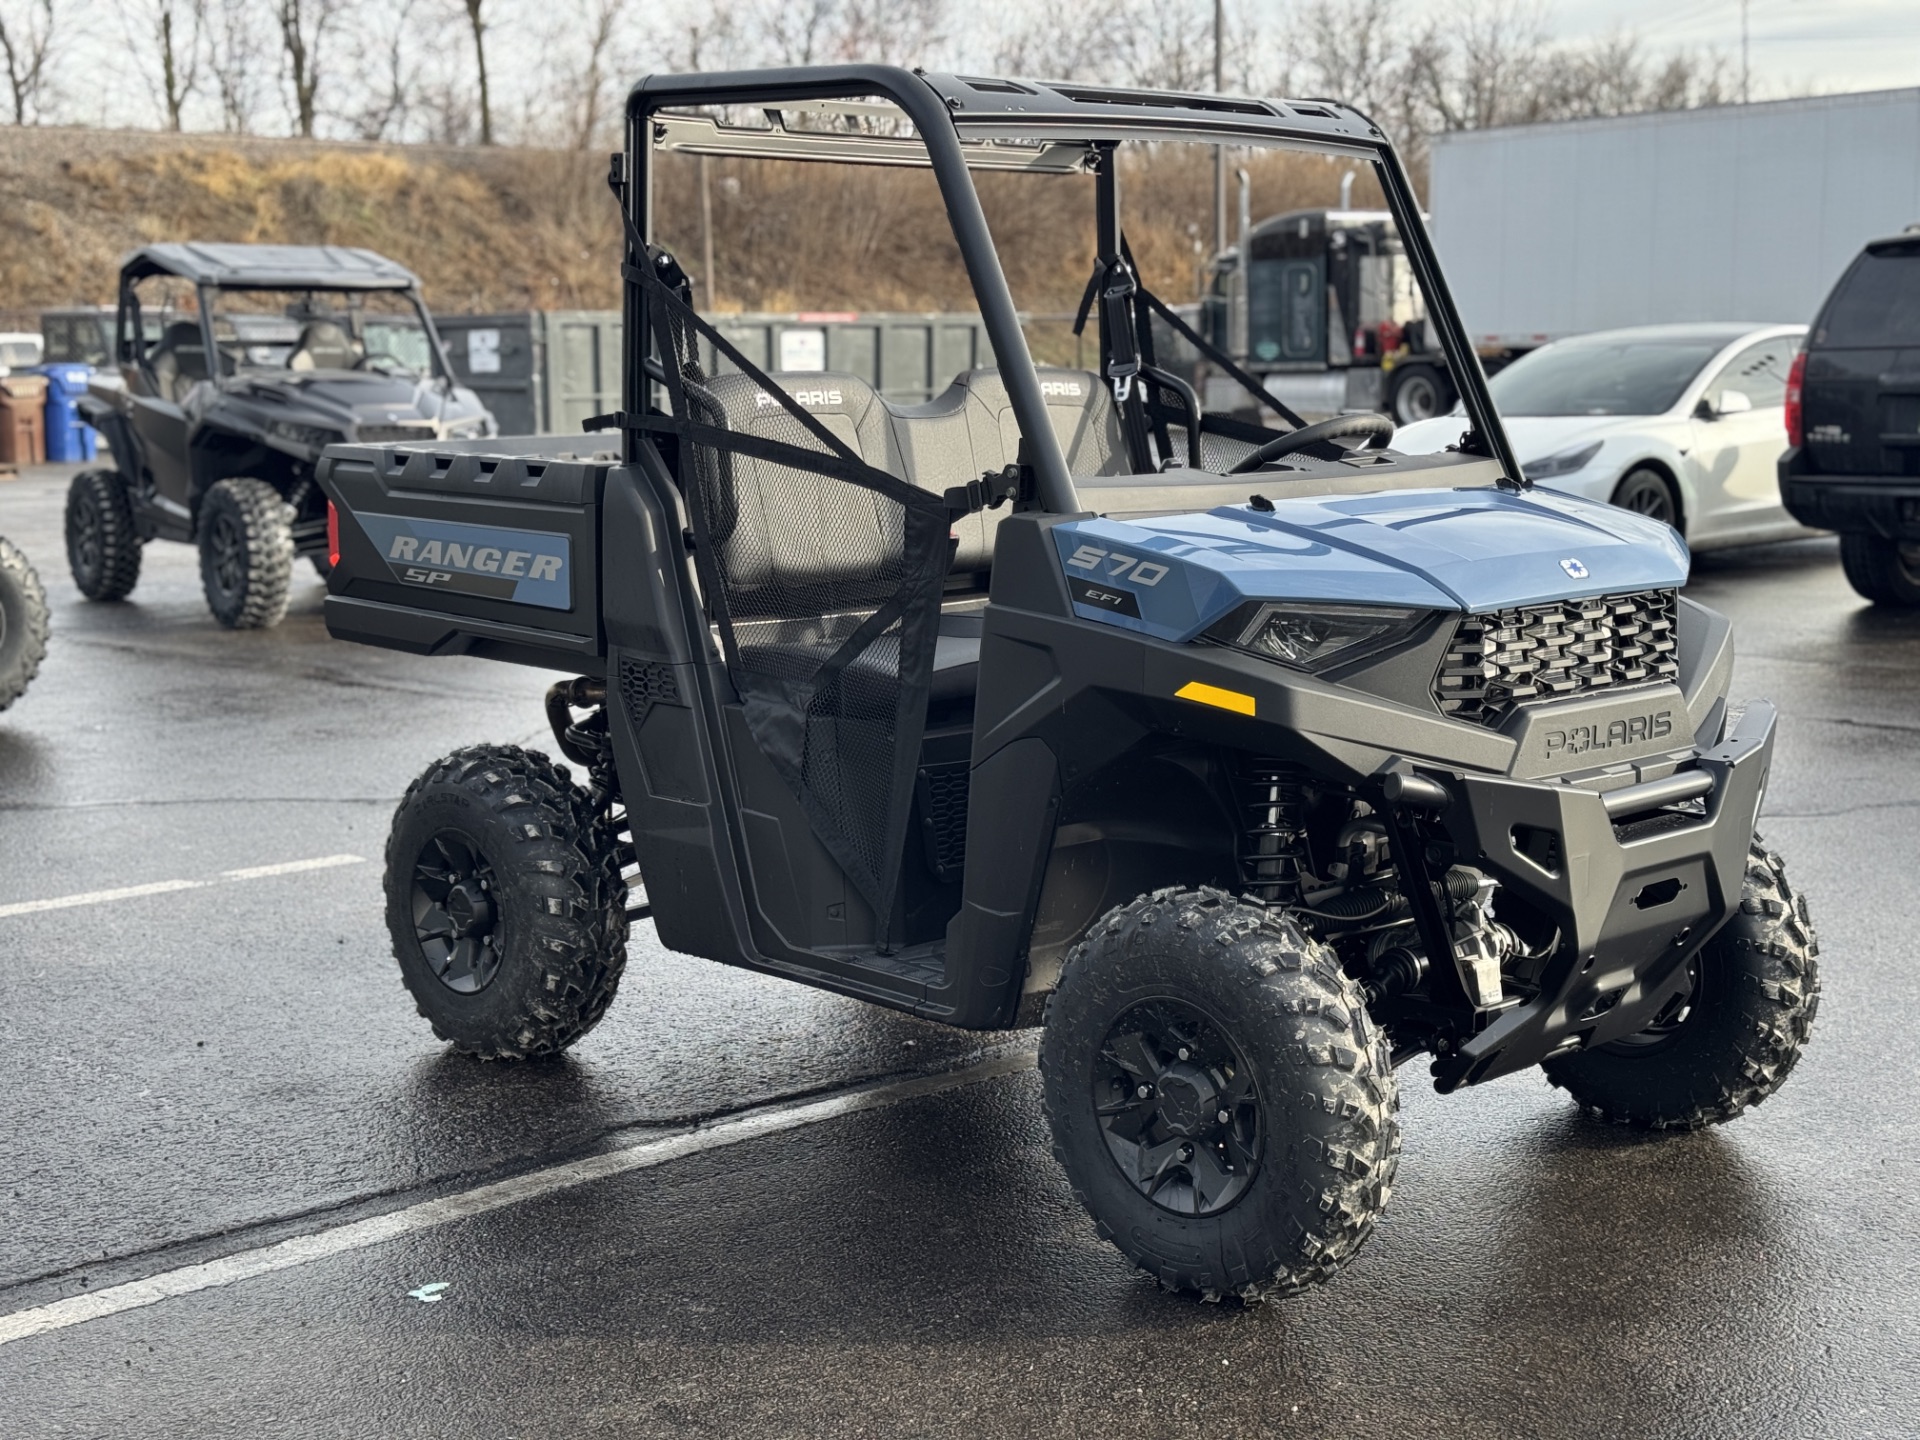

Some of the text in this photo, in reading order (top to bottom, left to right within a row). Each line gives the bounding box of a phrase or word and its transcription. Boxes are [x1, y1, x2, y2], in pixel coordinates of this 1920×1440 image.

[1041, 382, 1082, 396] ARIS
[389, 535, 563, 581] RANGER
[1067, 544, 1170, 587] 570
[403, 568, 452, 584] SP
[1085, 589, 1123, 605] EFI
[1544, 711, 1672, 760] POLARIS
